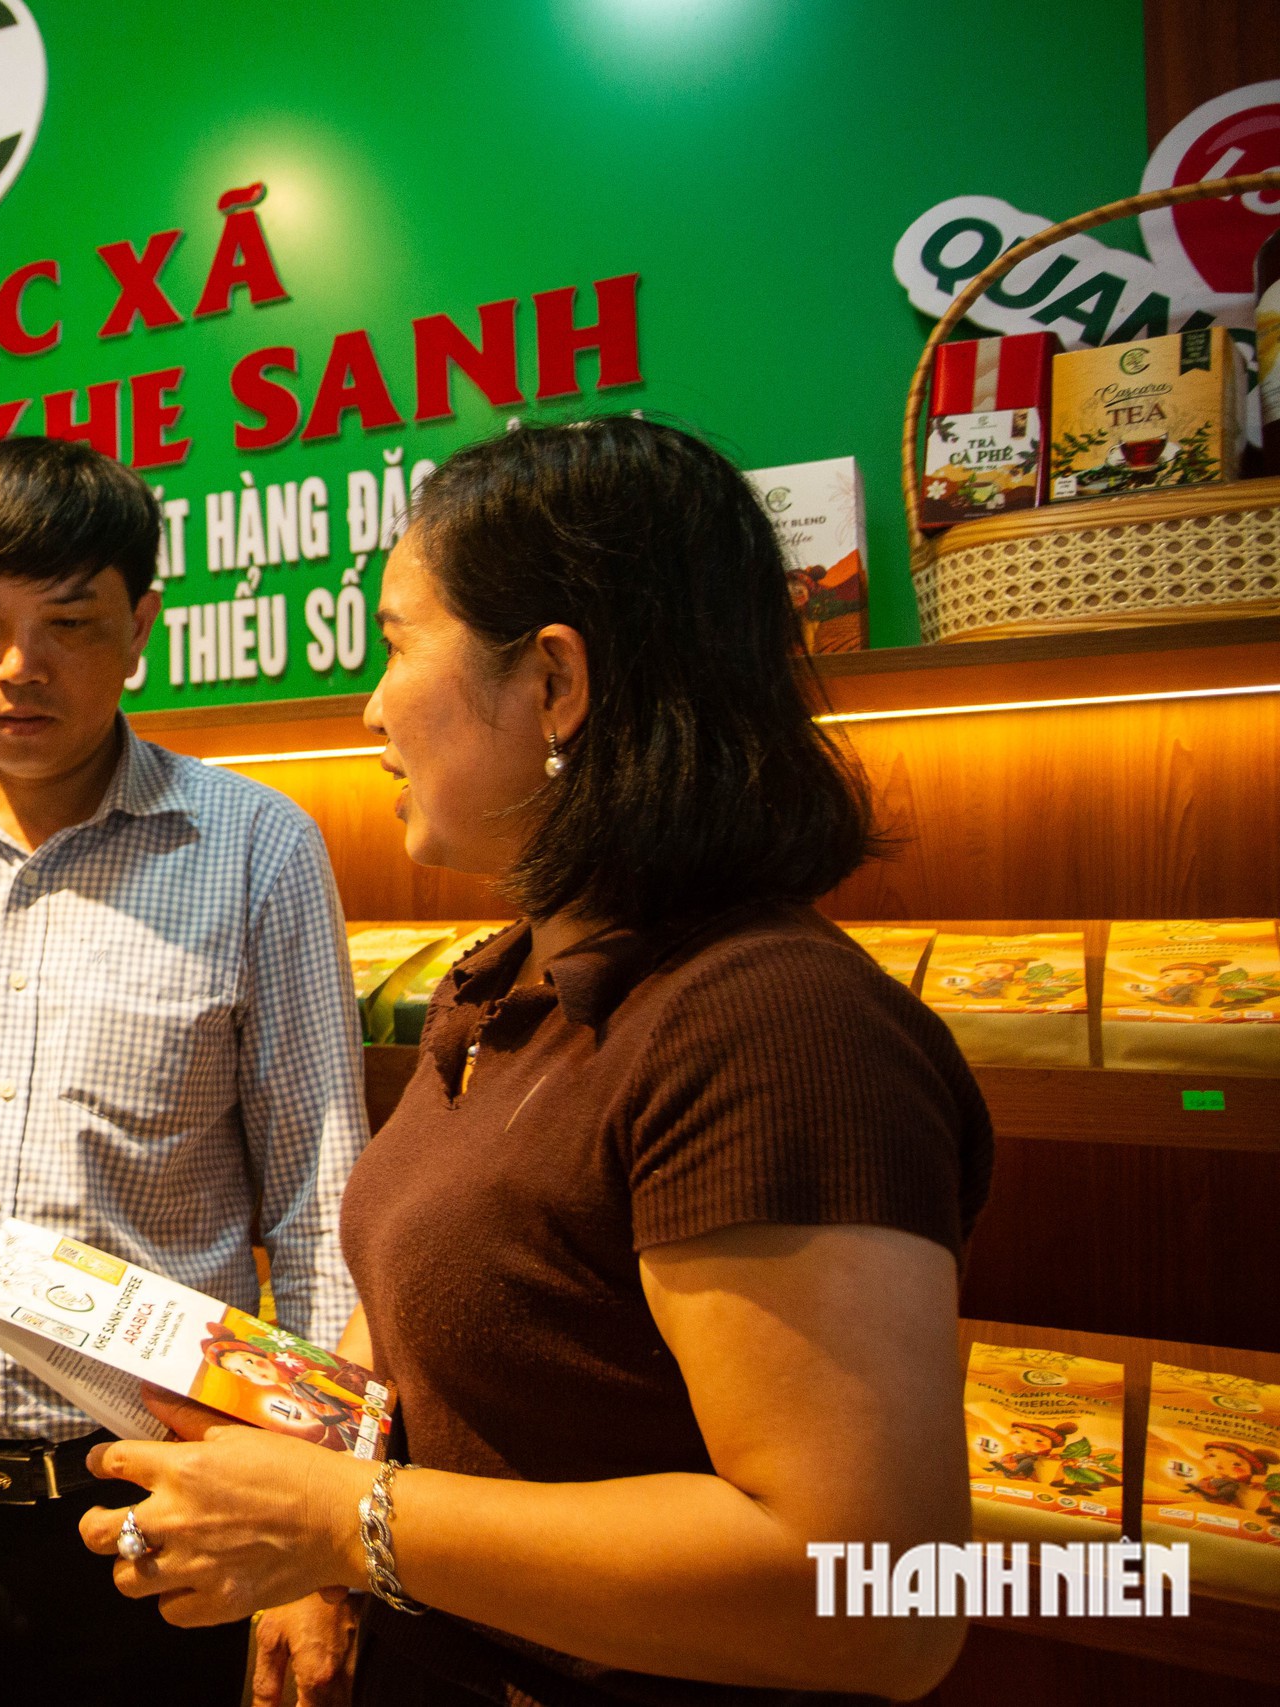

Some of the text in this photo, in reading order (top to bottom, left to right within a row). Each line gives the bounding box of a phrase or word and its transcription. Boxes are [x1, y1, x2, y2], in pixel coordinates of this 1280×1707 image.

[96, 182, 292, 339] XÃ
[229, 273, 644, 451] SANH
[1106, 403, 1167, 427] TEA
[949, 444, 1014, 466] CÀ PHÊ
[968, 435, 996, 450] TRÀ
[206, 470, 330, 575] HÀNG
[164, 554, 366, 686] THIỂU SỐ
[92, 1275, 143, 1351] KHE SANH COFFEE
[122, 1303, 155, 1345] ARABICA
[978, 1381, 1006, 1395] KHE
[1005, 1398, 1079, 1408] LIBERICA
